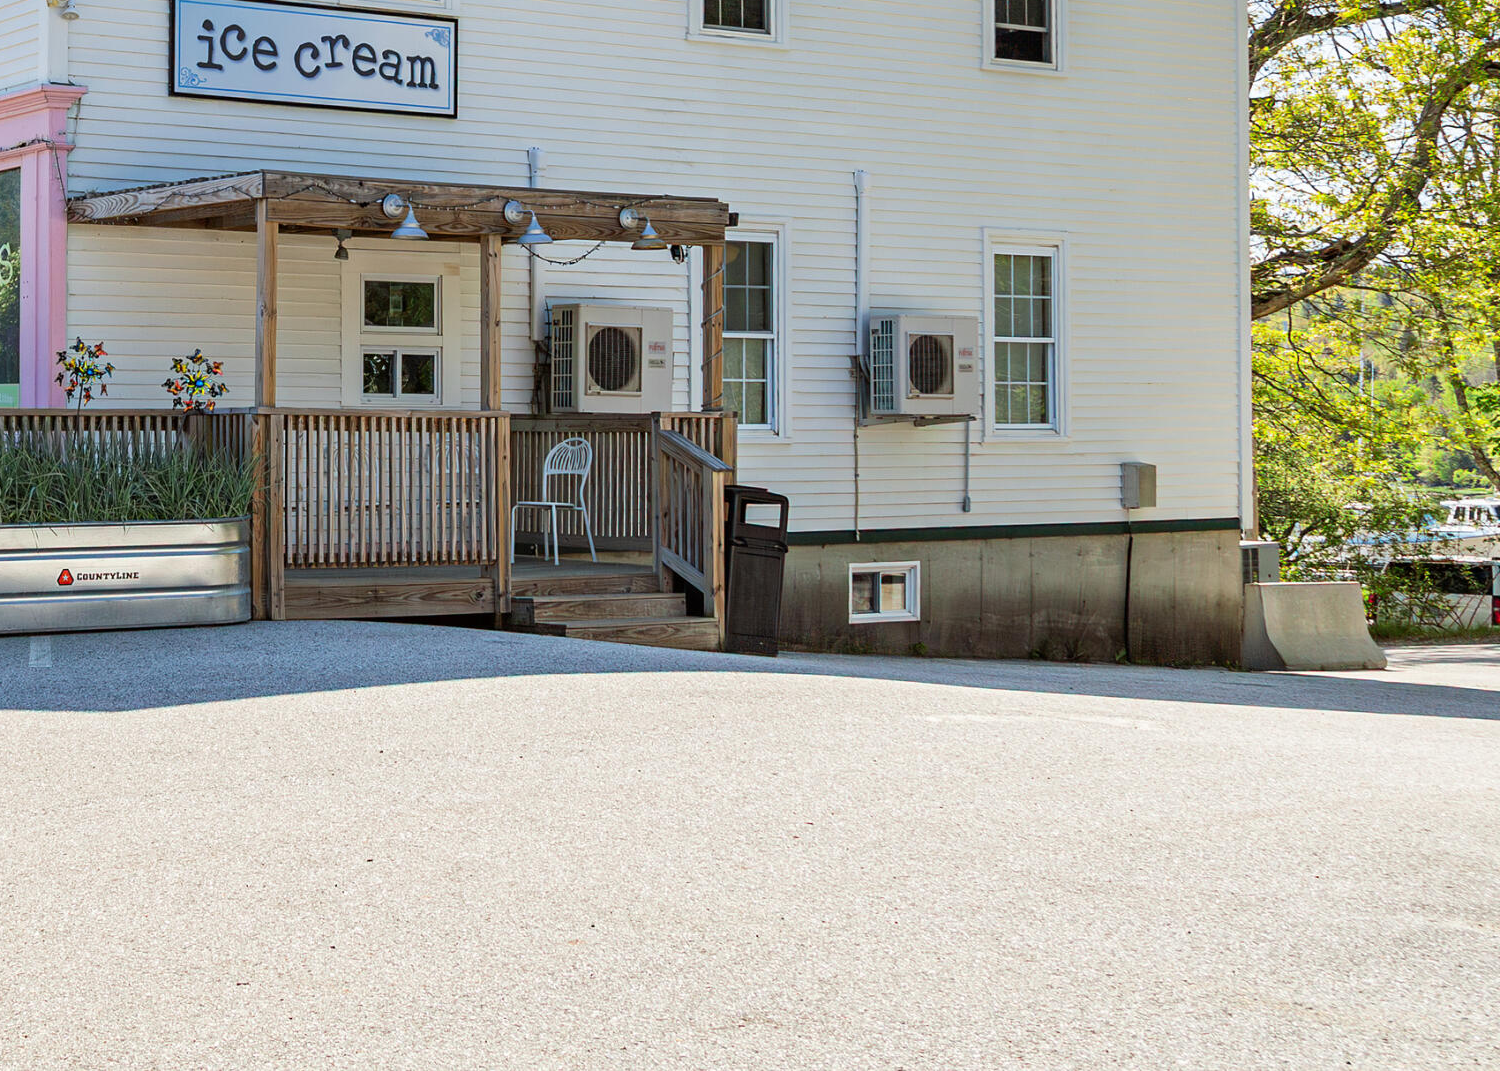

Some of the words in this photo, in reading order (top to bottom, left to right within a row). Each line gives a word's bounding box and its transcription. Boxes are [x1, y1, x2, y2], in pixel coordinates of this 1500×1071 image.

[197, 19, 278, 72] ice
[294, 34, 439, 90] cream
[76, 571, 140, 581] COUNTYLINE
